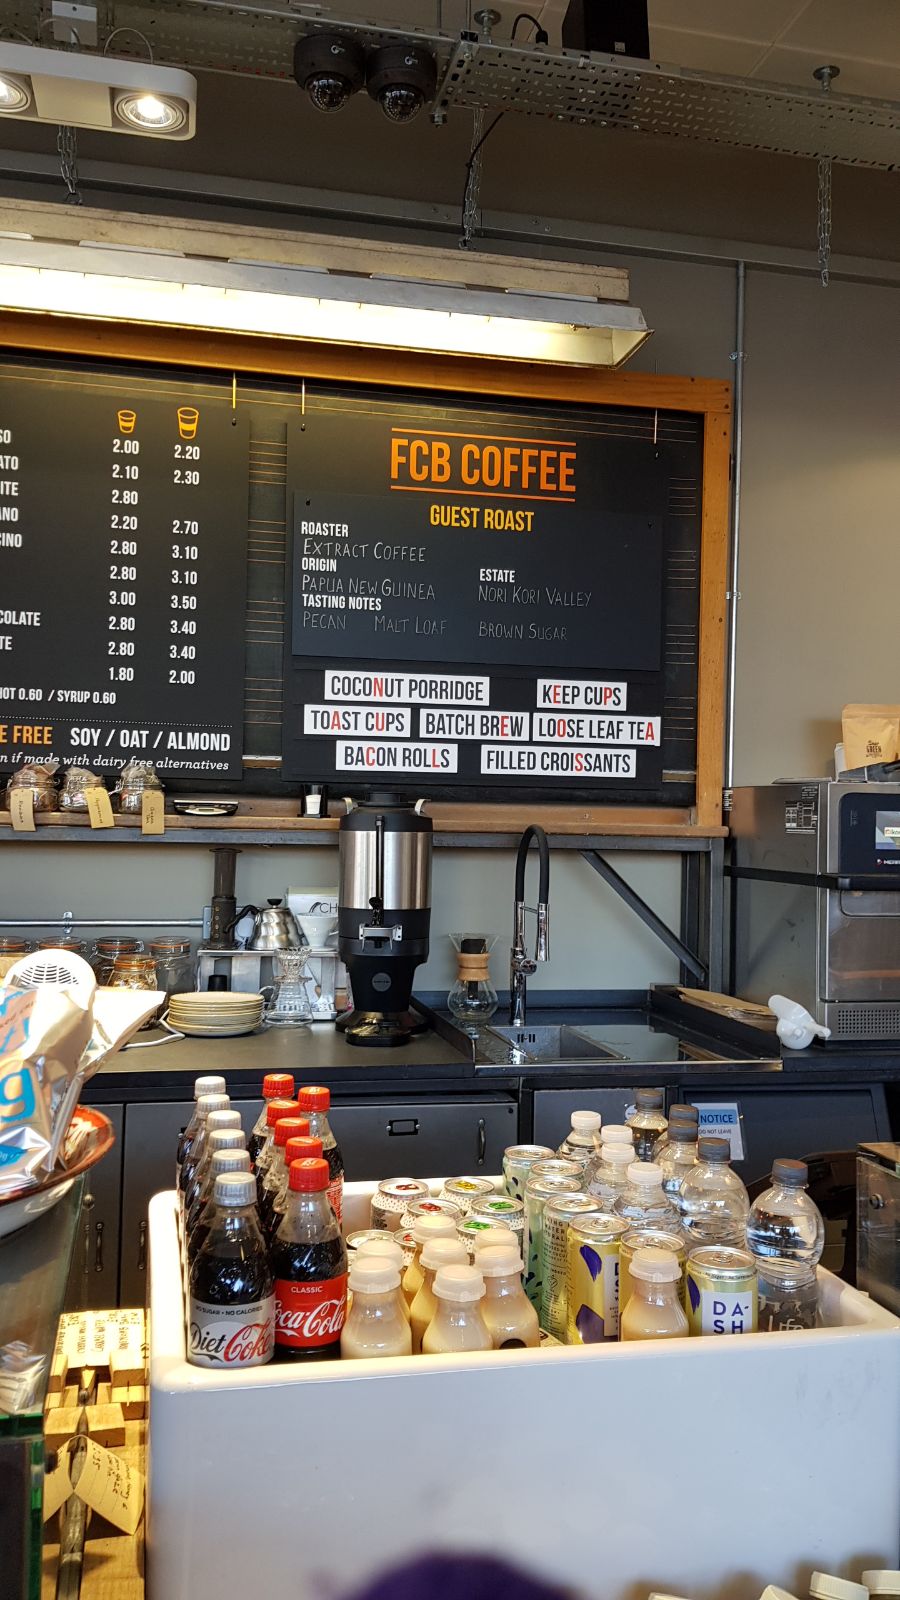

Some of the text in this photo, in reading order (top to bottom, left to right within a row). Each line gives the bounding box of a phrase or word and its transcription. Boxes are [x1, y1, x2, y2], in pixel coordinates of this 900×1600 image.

[113, 439, 200, 460] 2.00 2.20
[112, 464, 200, 485] 2.10 2.30
[391, 438, 576, 492] FCB COFFEE
[112, 489, 138, 505] 2.80
[111, 515, 198, 535] 2.20 2.70
[430, 504, 535, 532] GUEST ROAST
[301, 521, 349, 538] ROASTER
[110, 540, 198, 560] 2.80 3.10
[303, 538, 426, 562] EXTRACT COFFEE
[110, 565, 197, 585] 2.80 3.10
[301, 557, 516, 583] ORIGIN ESTATE
[302, 574, 436, 601] PAPUA NEW GUINEA
[479, 585, 592, 608] NORI KORI VALLEY
[109, 591, 197, 610] 3.00 3.50
[302, 594, 382, 611] TASTING NOTES
[109, 616, 196, 635] 2.80 3.40
[303, 612, 347, 631] PECAN
[415, 618, 448, 636] LOAF
[479, 621, 567, 641] BROWN SUGAR
[108, 641, 196, 660] 2.80 3.40
[108, 667, 195, 685] 1.80 2.00
[18, 688, 43, 701] 0.60
[57, 690, 90, 703] SYRUP
[92, 691, 117, 704] 0.60
[331, 676, 484, 701] COCONUT PORRIDGE
[542, 684, 621, 707] KEEP CUPS
[310, 710, 405, 732] TOAST CUPS
[426, 714, 523, 738] BATCH BREW
[538, 717, 655, 741] LOOSE LEAF TEA
[13, 725, 53, 745] FREE
[70, 728, 101, 748] SOY
[119, 729, 149, 748] OAT
[167, 731, 231, 751] ALMOND
[11, 752, 23, 763] if
[24, 753, 60, 766] made
[63, 754, 90, 766] with
[93, 755, 126, 770] dairy
[129, 756, 153, 769] free
[156, 758, 229, 771] alternatives
[344, 746, 450, 768] BACON ROLLS
[487, 750, 631, 773] FILLED CROISSANTS
[700, 1114, 733, 1124] NOTICE
[190, 1319, 272, 1362] Diet Coke
